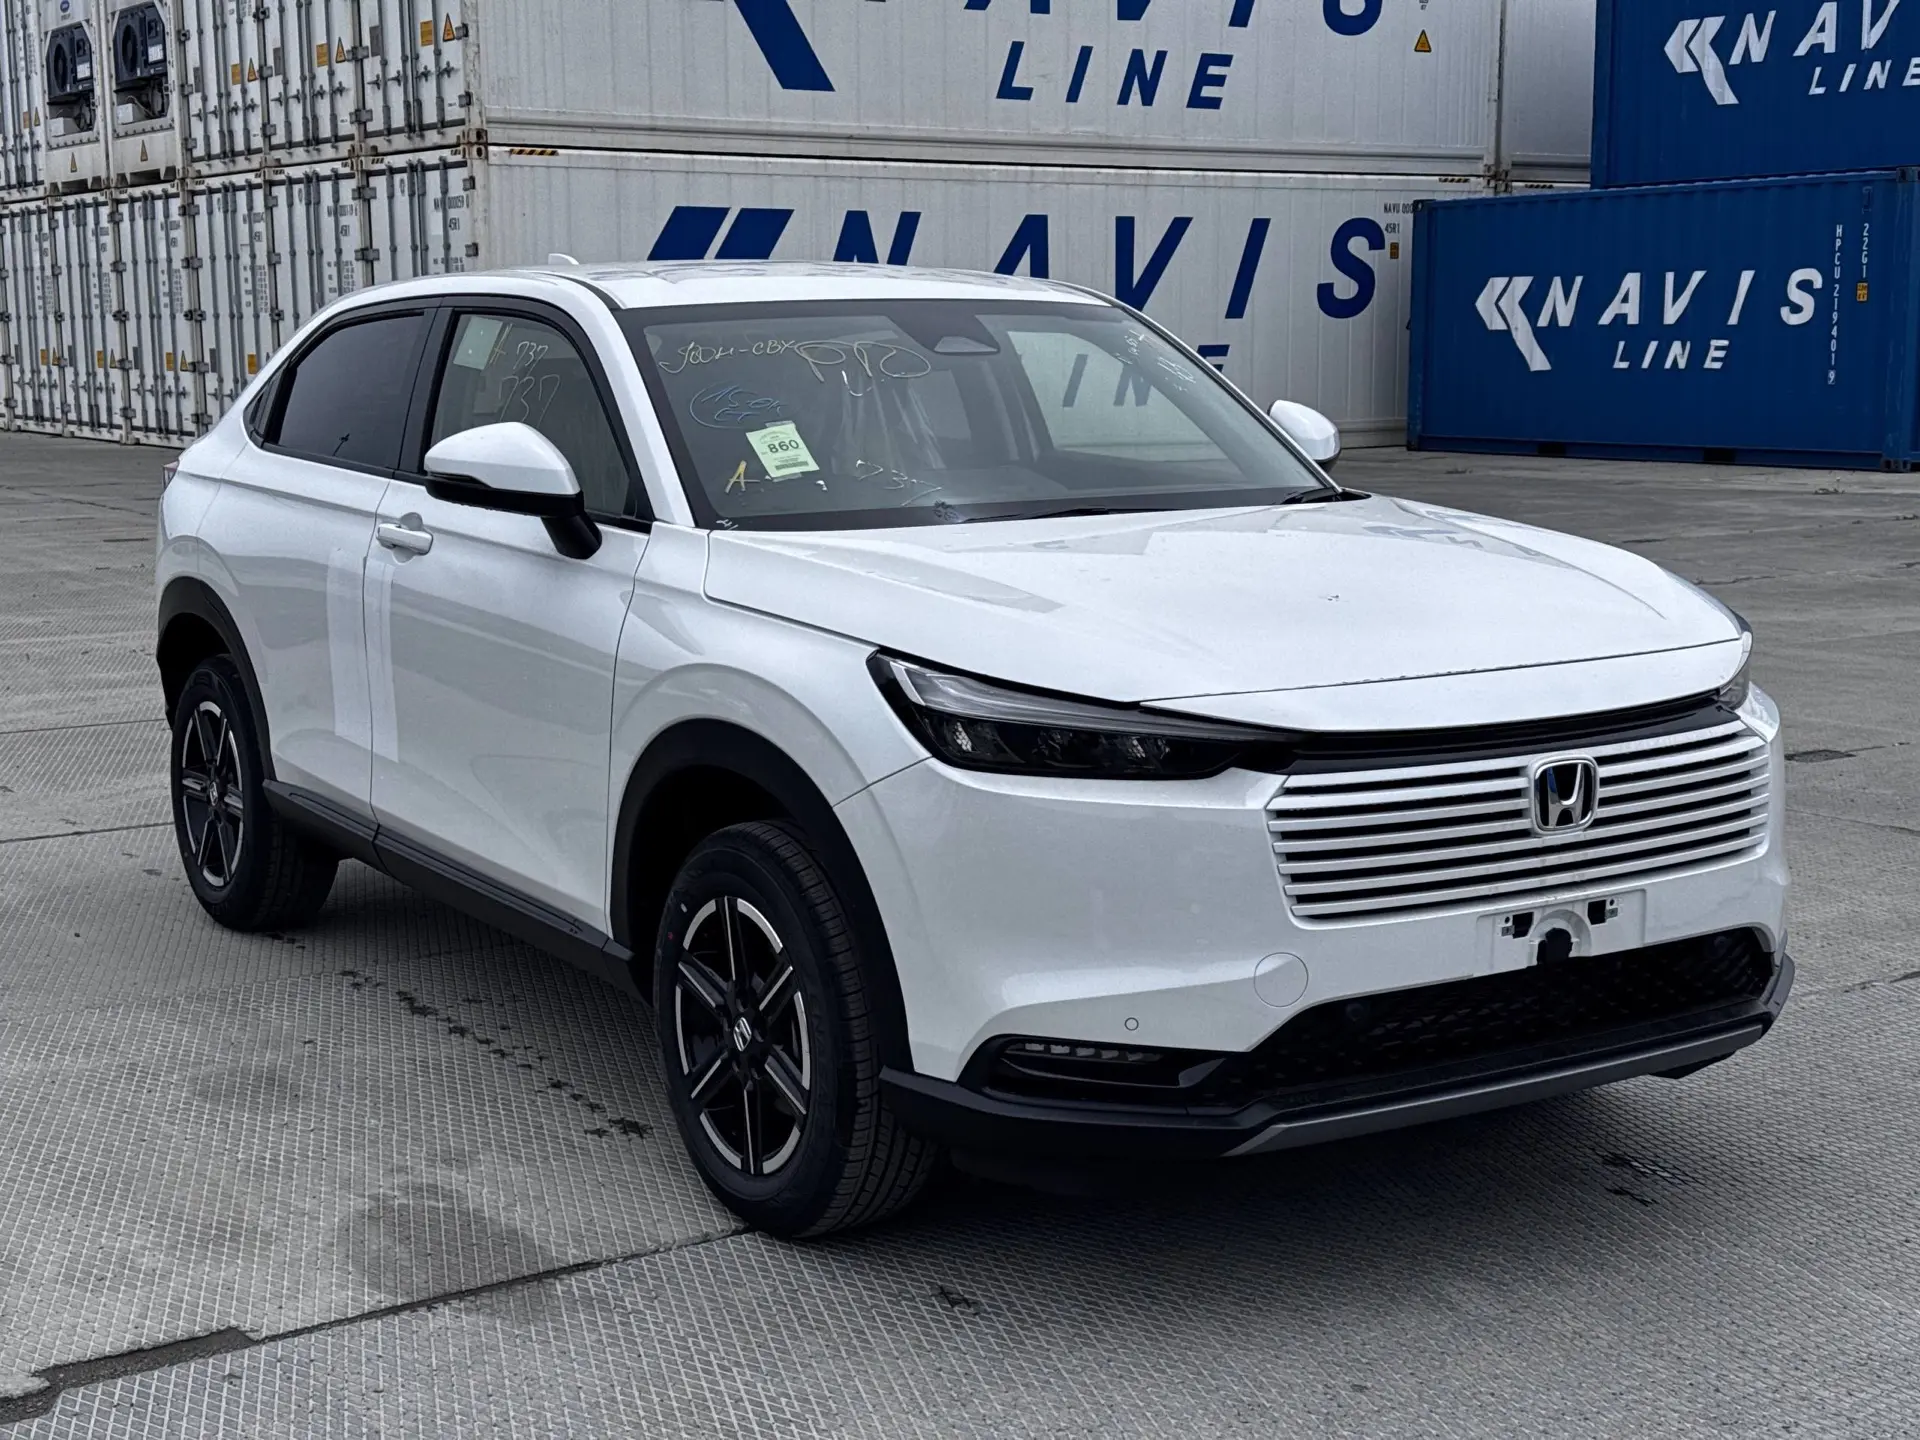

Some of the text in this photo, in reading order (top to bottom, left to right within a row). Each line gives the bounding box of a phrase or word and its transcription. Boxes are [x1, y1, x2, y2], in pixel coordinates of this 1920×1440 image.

[996, 41, 1234, 110] LINE
[1807, 56, 1920, 96] LINE
[1384, 222, 1400, 234] 45R1
[1834, 224, 1843, 280] HPCU
[1861, 222, 1870, 279] 22G1
[1536, 267, 1823, 327] NAVIS
[1830, 283, 1840, 366] 219401
[1613, 339, 1730, 370] LINE
[767, 439, 800, 454] 860
